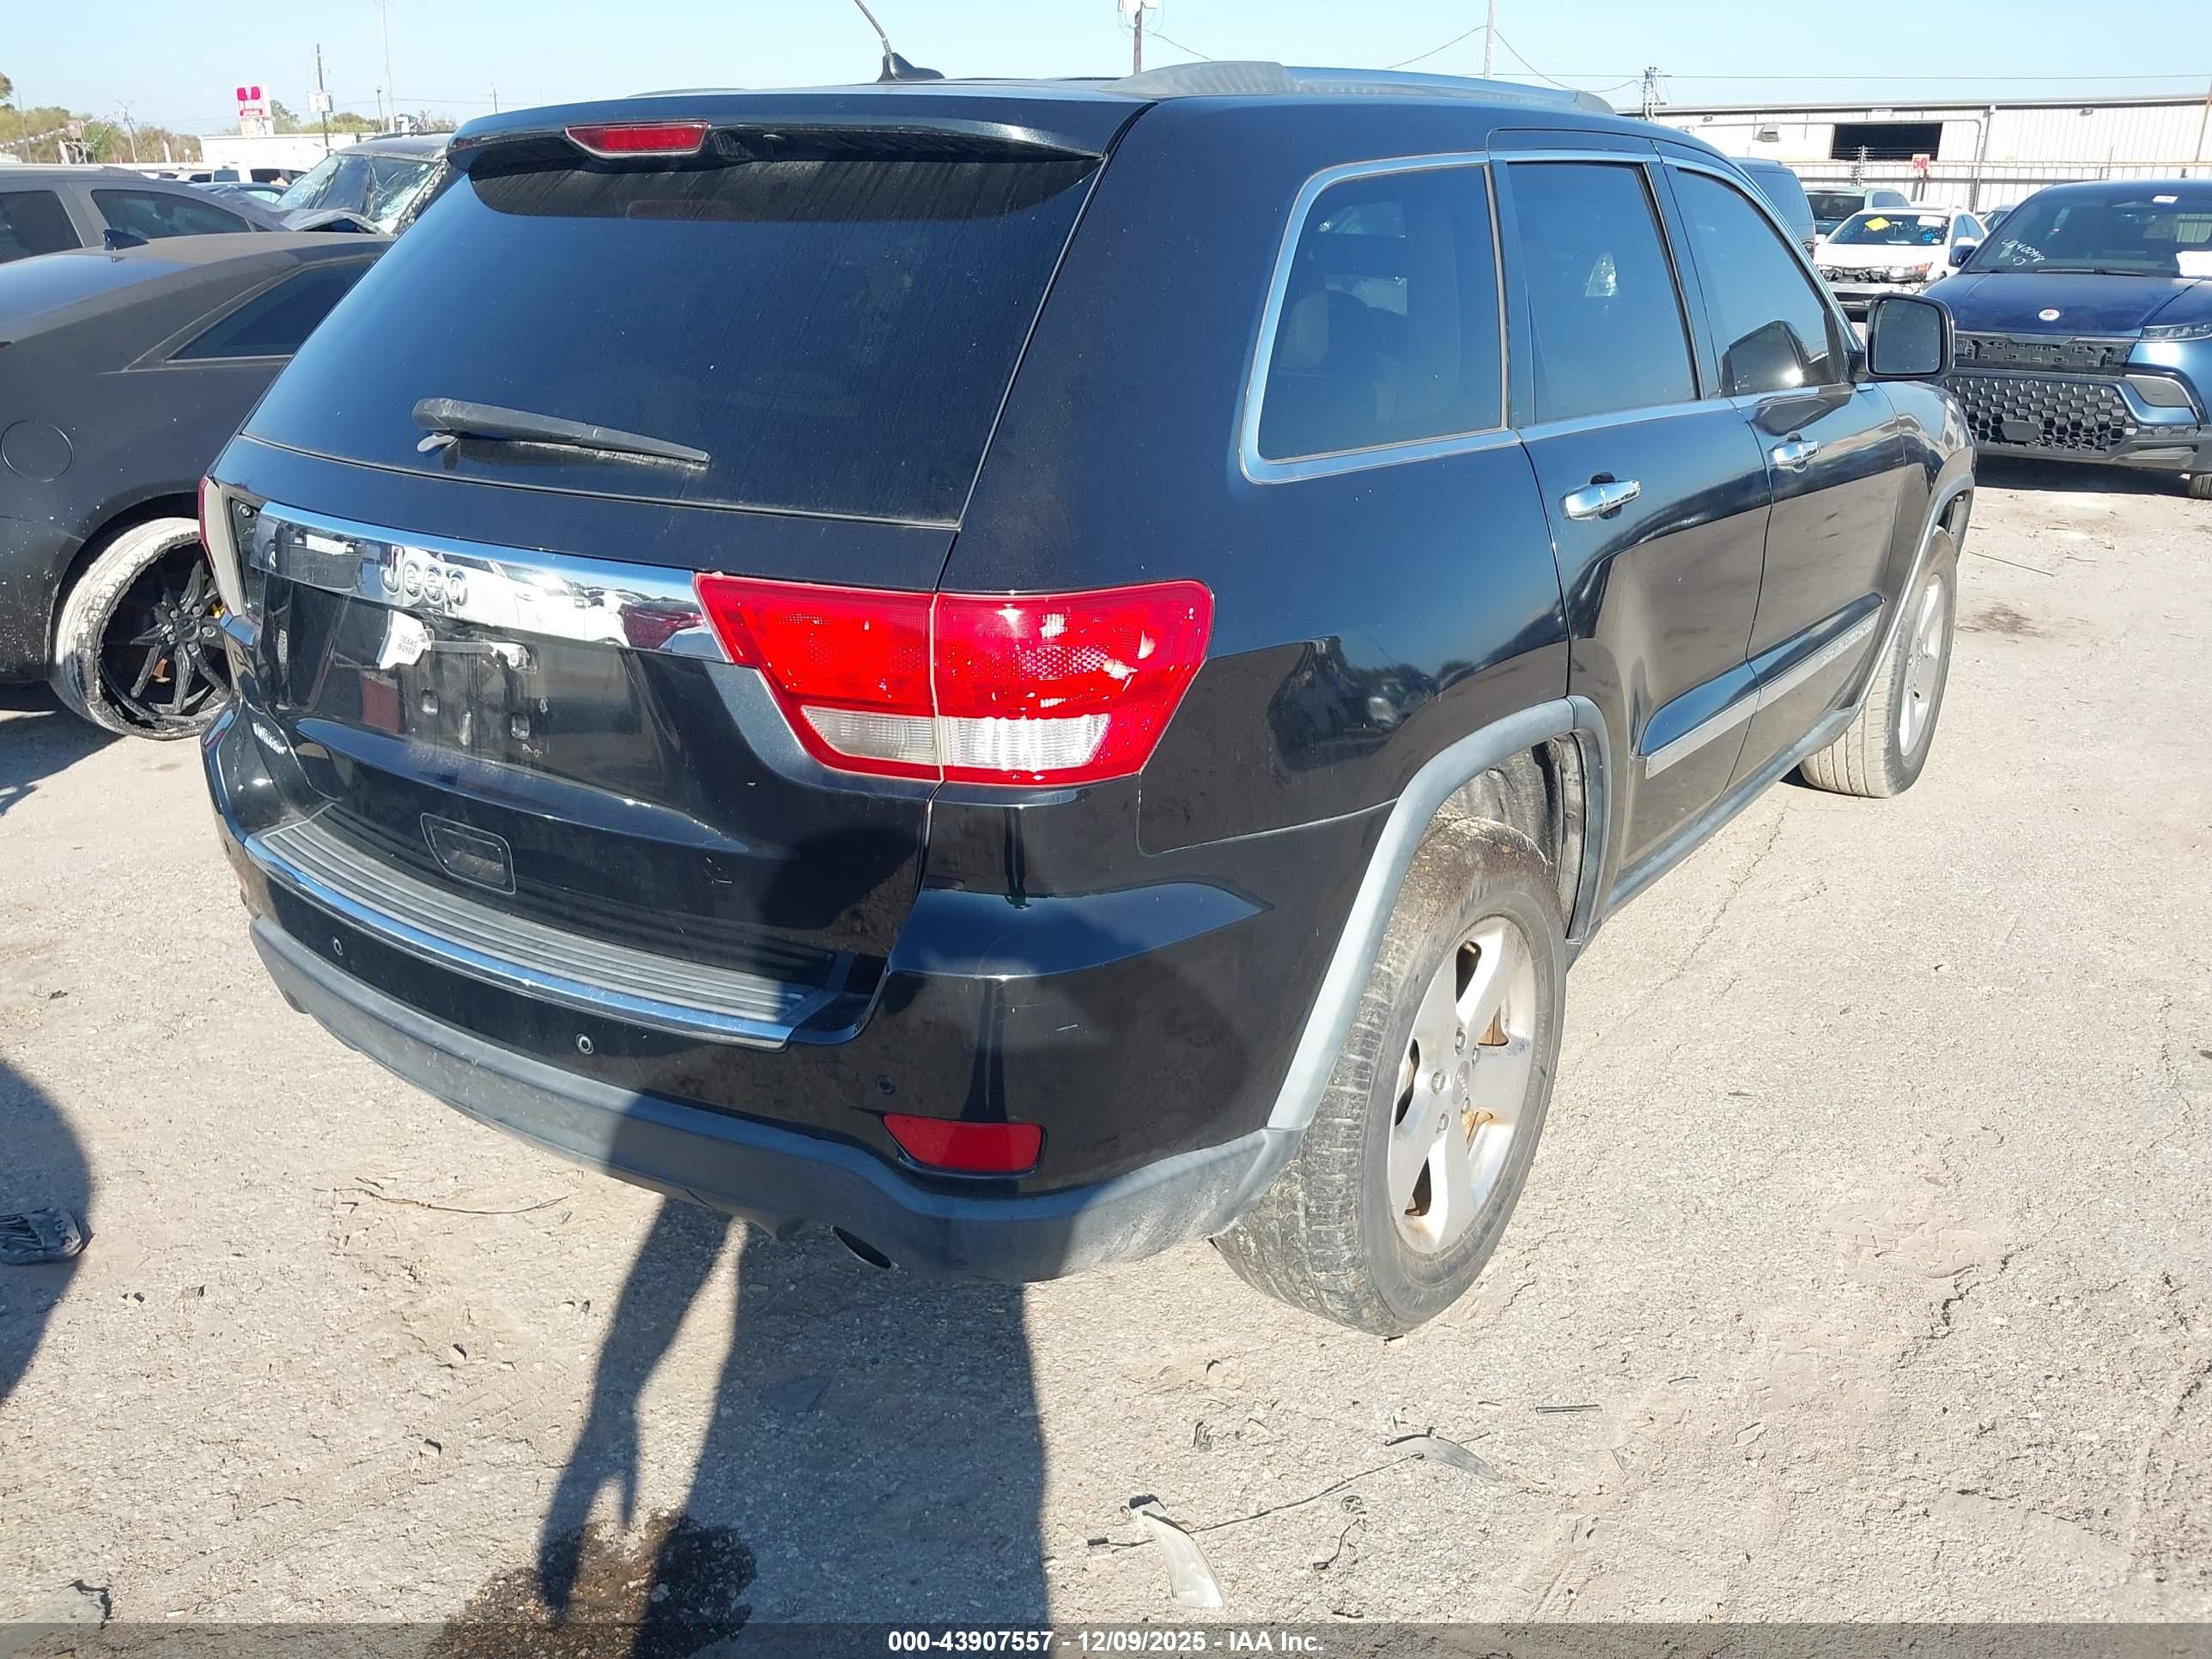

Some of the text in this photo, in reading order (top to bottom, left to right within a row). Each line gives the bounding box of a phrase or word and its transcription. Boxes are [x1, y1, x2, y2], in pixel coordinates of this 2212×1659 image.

[1912, 157, 1928, 169] 50
[380, 546, 468, 610] Jeep
[400, 635, 418, 648] TEXAS
[398, 642, 416, 656] BUYER
